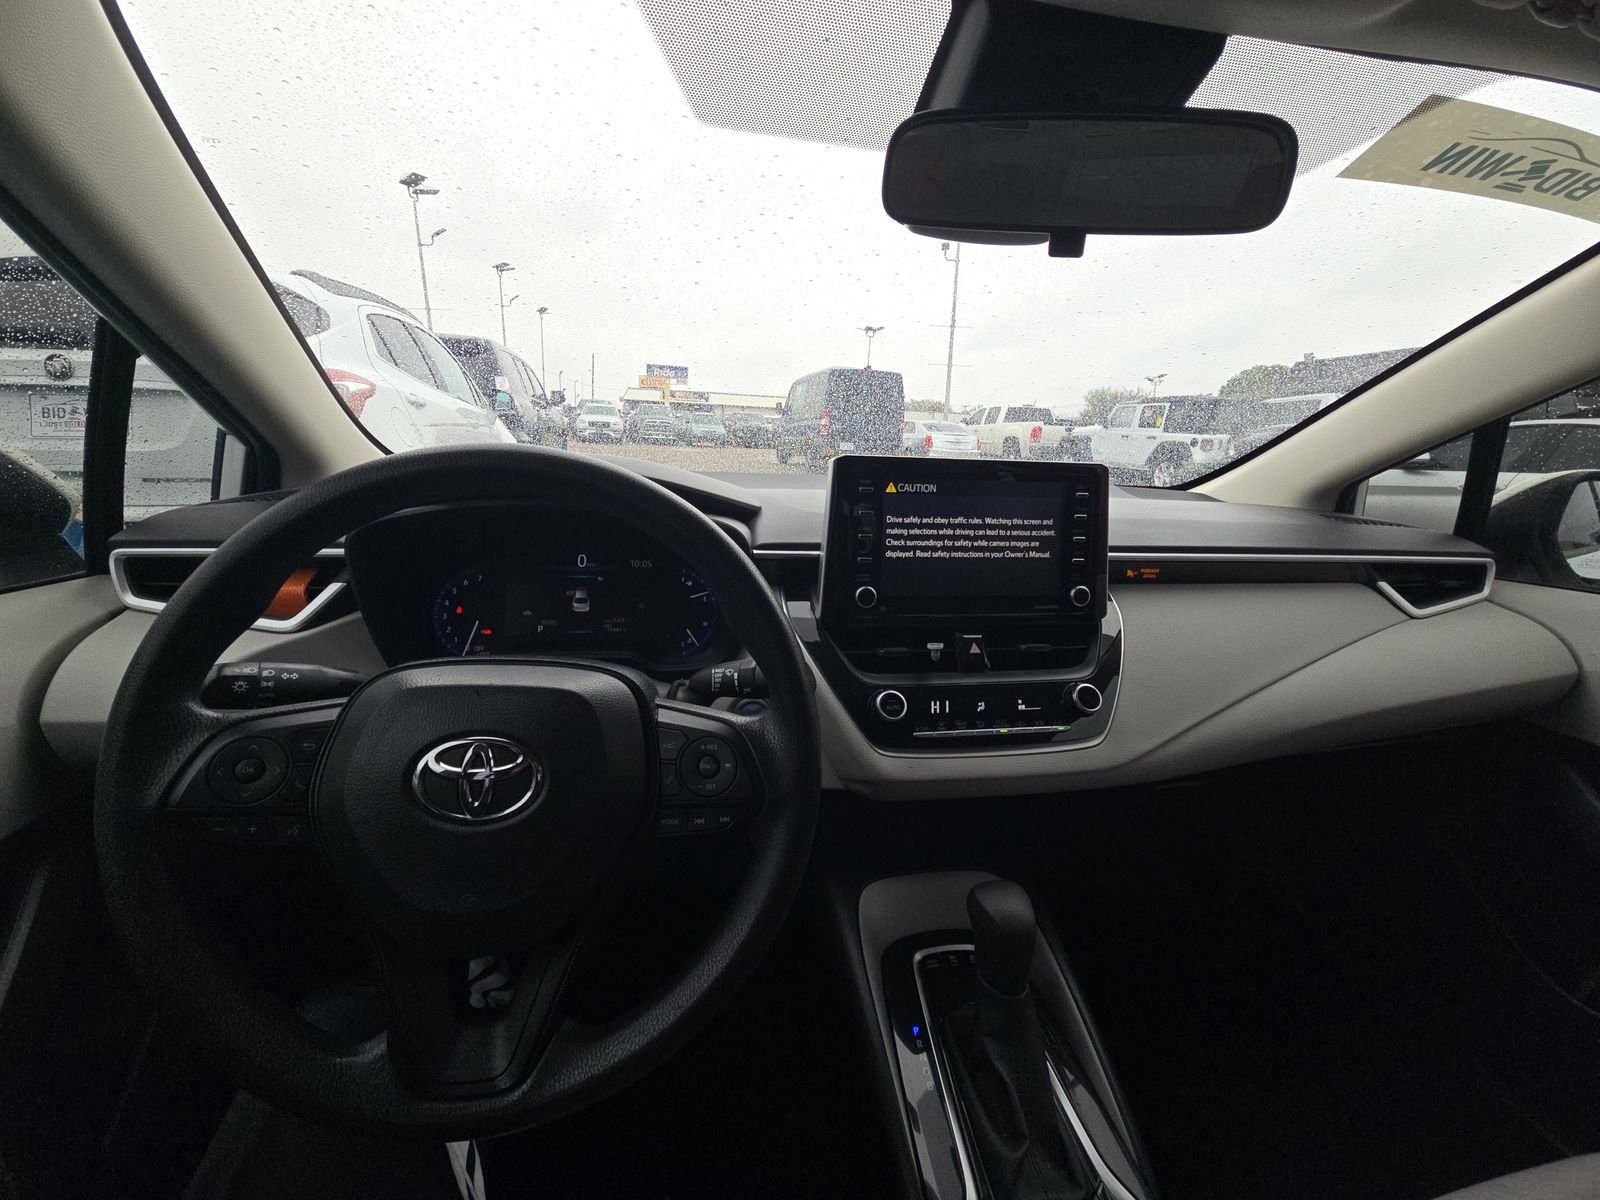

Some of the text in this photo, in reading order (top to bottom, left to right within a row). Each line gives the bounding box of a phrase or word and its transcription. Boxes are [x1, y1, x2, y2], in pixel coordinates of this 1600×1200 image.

[42, 406, 66, 418] BID
[898, 484, 937, 492] CAUTION
[904, 516, 921, 524] safely
[934, 516, 949, 525] obey
[985, 517, 1012, 526] Watching
[886, 528, 908, 536] making
[906, 539, 943, 547] surroundings
[577, 554, 587, 567] 0
[630, 560, 652, 568] 10:05
[538, 625, 544, 633] P
[913, 1025, 920, 1036] P
[916, 1040, 923, 1048] R
